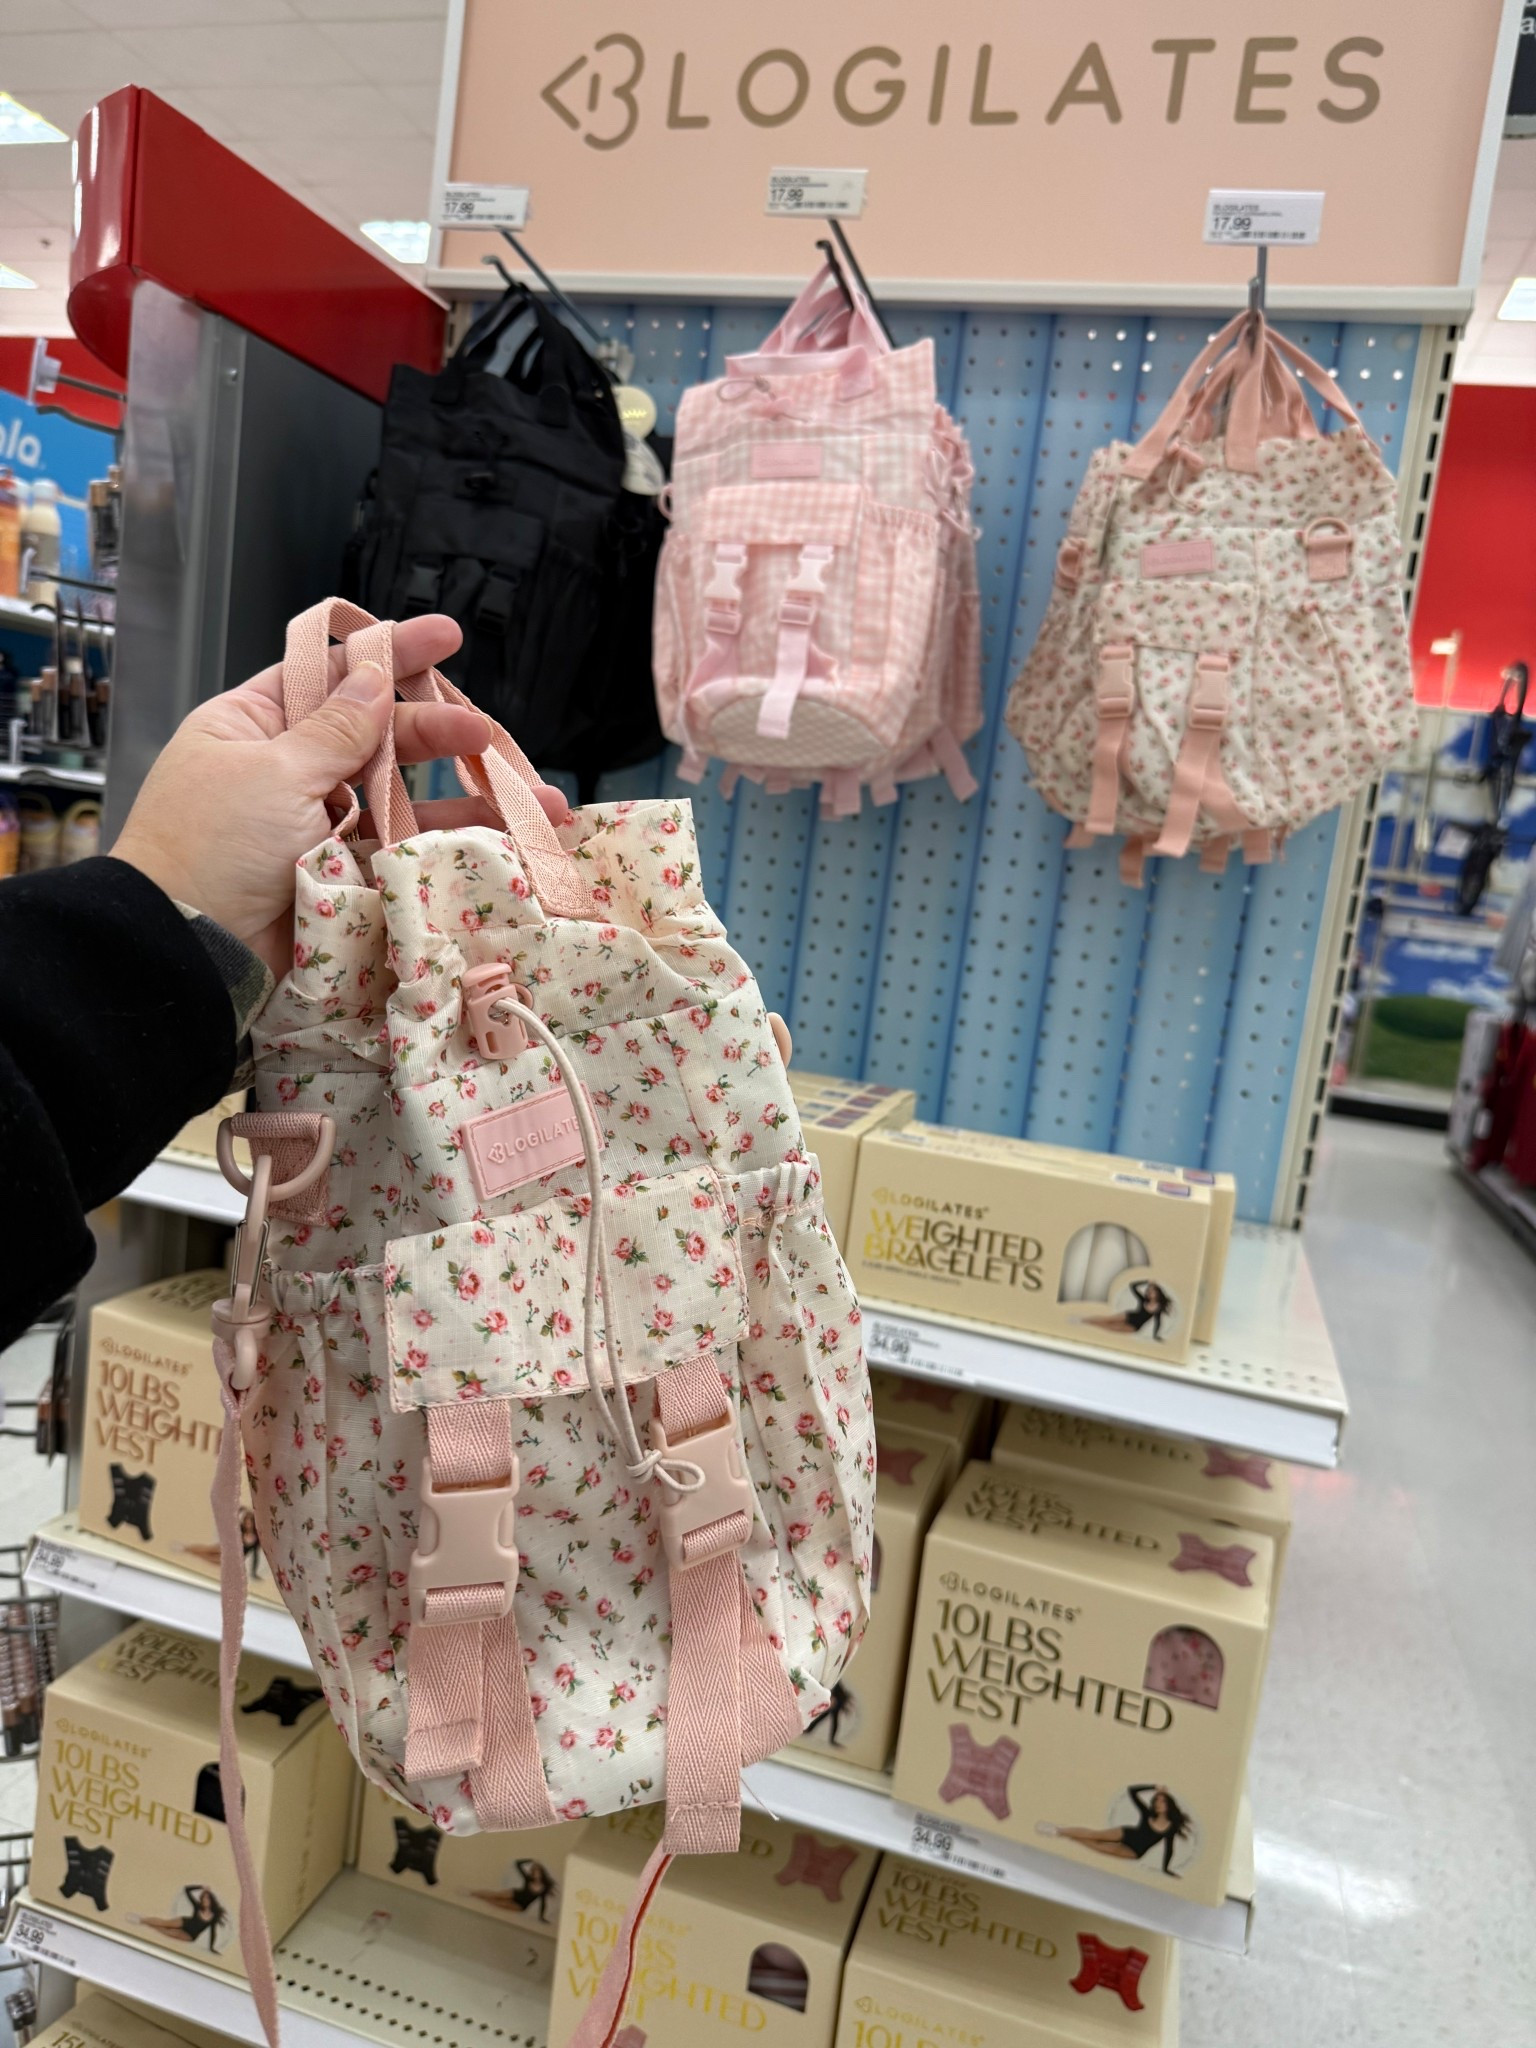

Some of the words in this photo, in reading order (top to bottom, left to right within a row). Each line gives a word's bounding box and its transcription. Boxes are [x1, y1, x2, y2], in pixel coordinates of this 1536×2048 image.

[540, 33, 1386, 152] BLOGILATES
[1213, 217, 1251, 231] 17.99
[487, 1115, 581, 1164] BLOGILATE
[864, 1232, 1044, 1292] BRACELETS
[870, 1207, 1044, 1263] WEIGHTED
[98, 1359, 181, 1413] 10LBS
[96, 1390, 223, 1455] WEIGHT
[96, 1418, 164, 1466] VEST
[939, 1571, 1077, 1623] BLOGILATES
[937, 1598, 1064, 1662] 10LBS
[927, 1667, 1035, 1728] VEST
[932, 1632, 1174, 1734] WEIGHTED
[55, 1738, 140, 1790] 10LBS
[49, 1791, 121, 1840] VEST
[52, 1765, 213, 1847] WEIGHTED
[892, 1870, 981, 1912] 10LBS
[878, 1905, 952, 1949] VEST
[885, 1887, 1059, 1960] WEIGHTED
